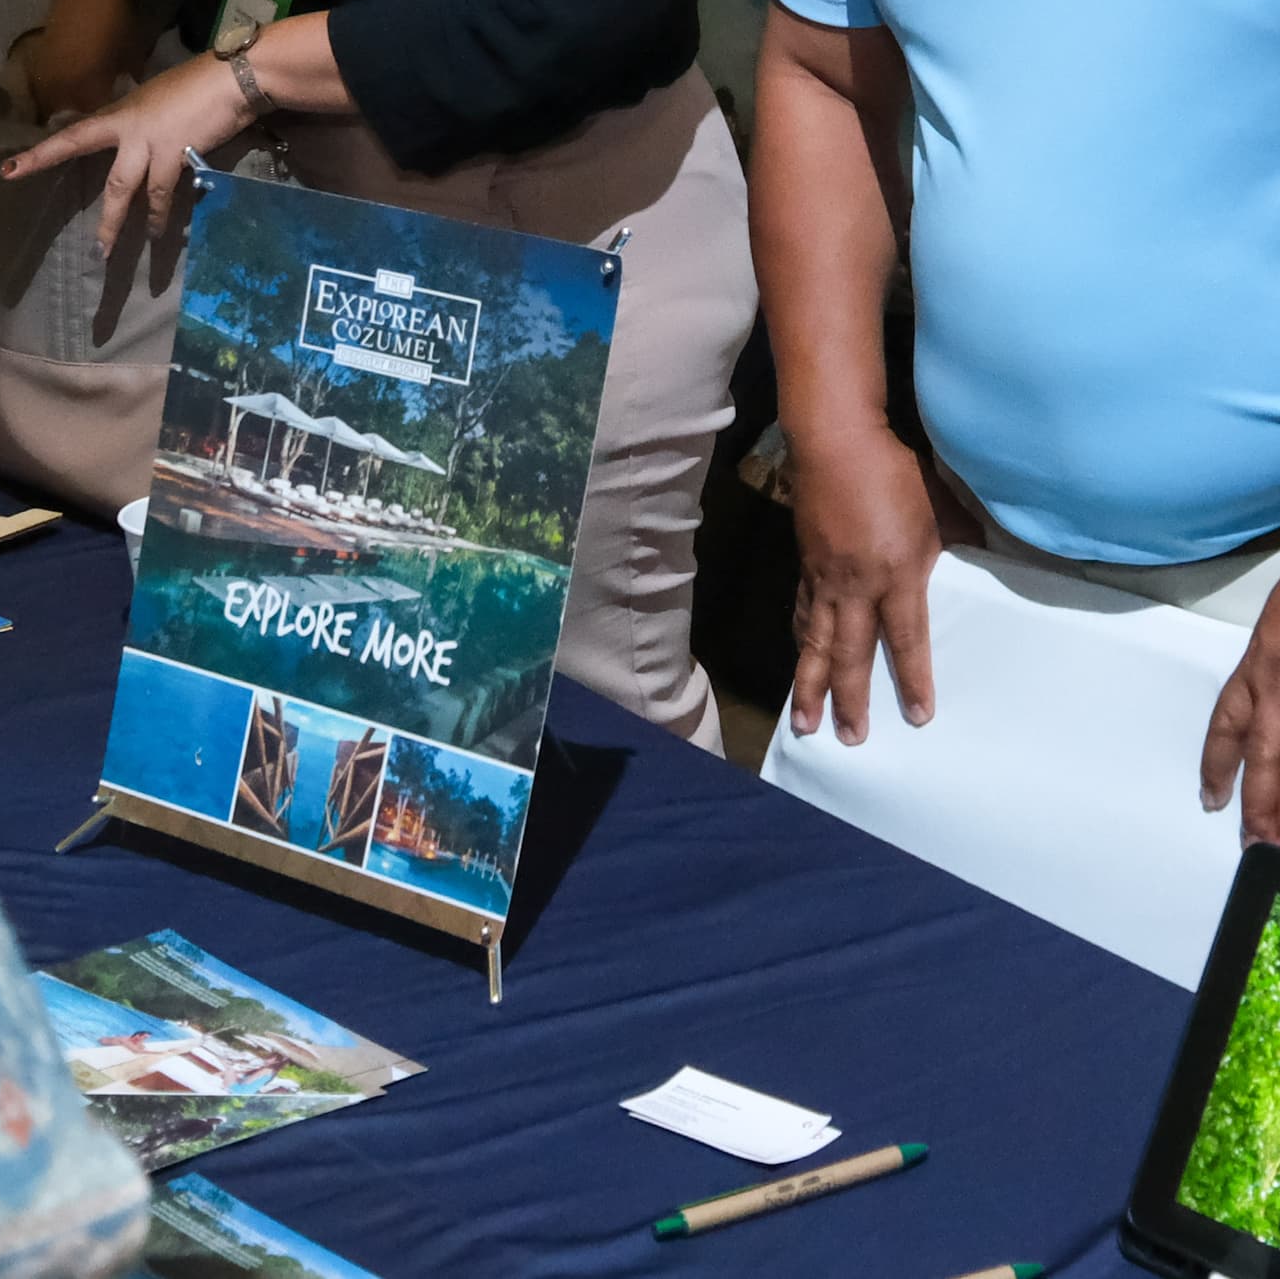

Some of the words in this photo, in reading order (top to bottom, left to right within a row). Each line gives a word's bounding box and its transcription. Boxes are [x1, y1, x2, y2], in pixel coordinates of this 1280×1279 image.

[314, 279, 468, 345] EXPLOREAN
[331, 317, 441, 364] COZUMEL
[224, 581, 357, 656] EXPLORE
[359, 619, 458, 686] MORE
